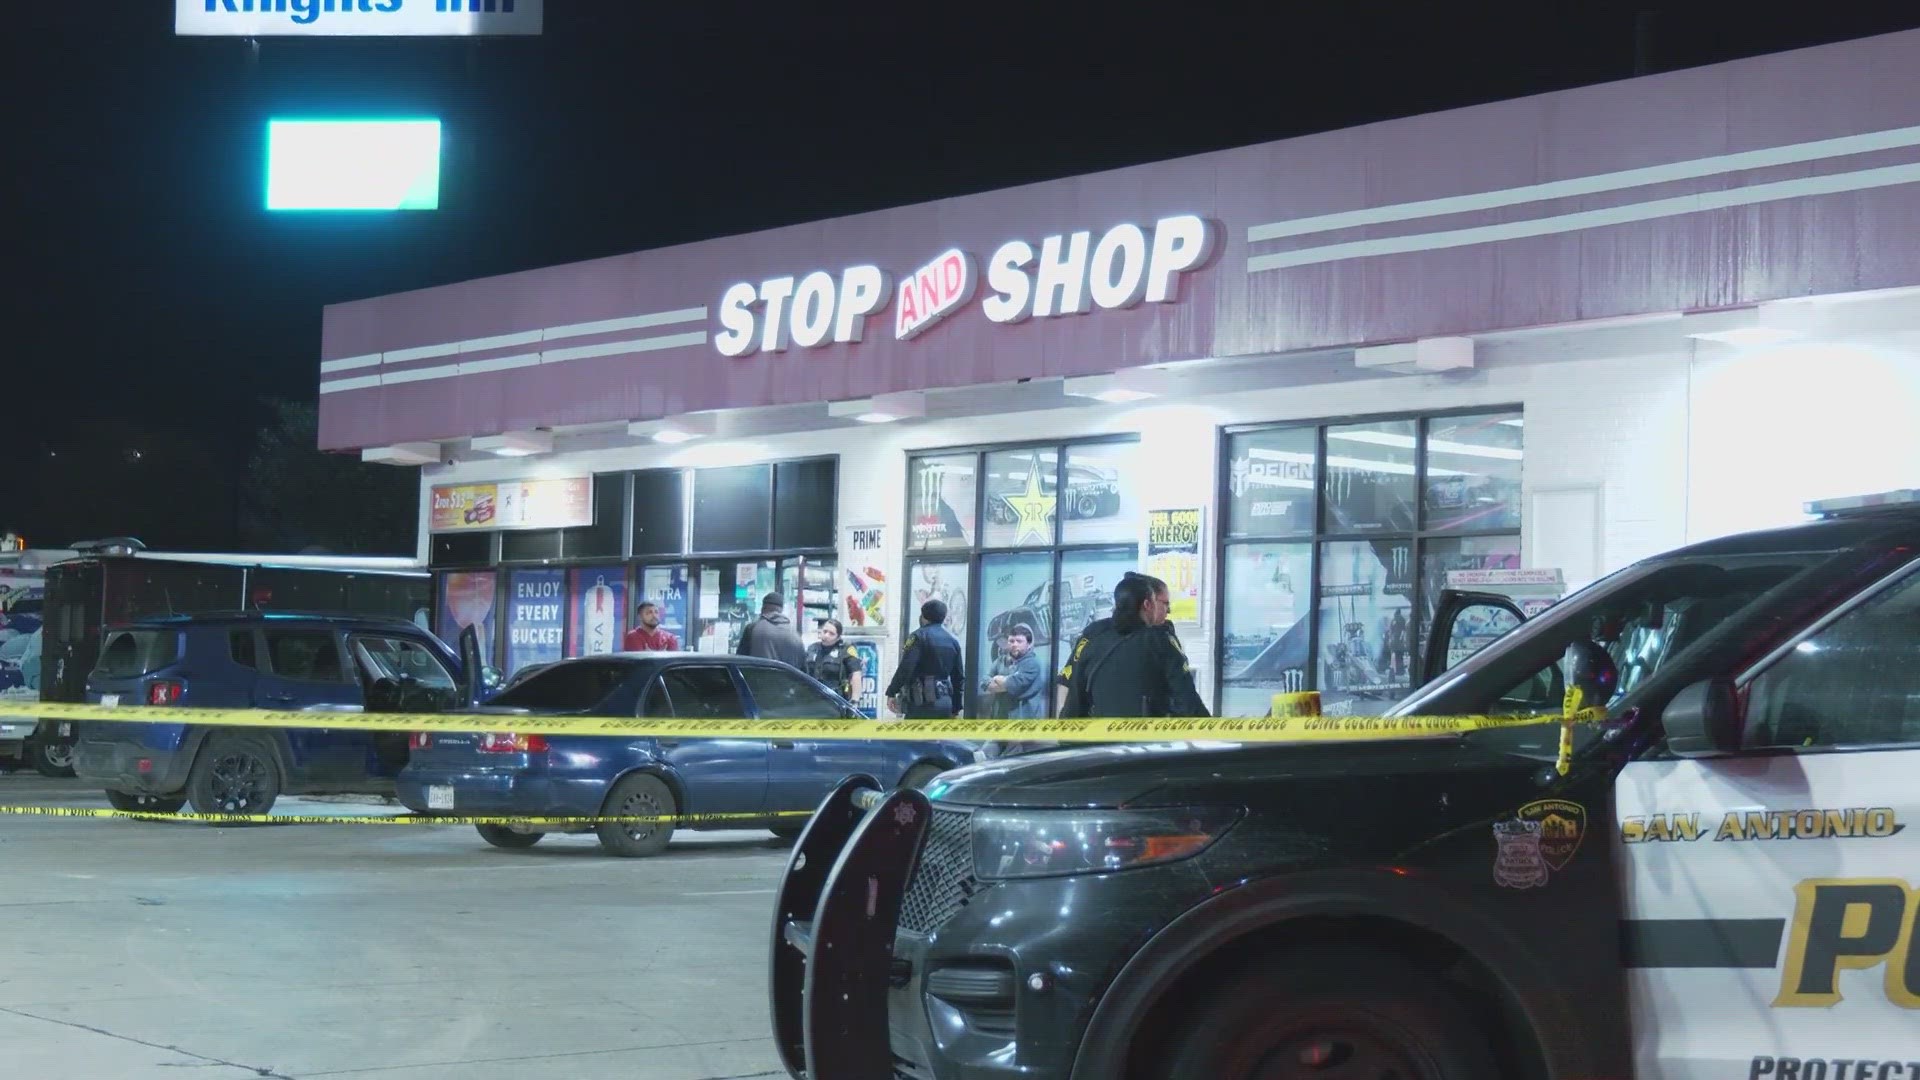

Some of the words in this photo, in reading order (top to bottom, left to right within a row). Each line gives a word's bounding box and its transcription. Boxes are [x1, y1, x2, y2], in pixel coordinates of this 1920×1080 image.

[714, 264, 892, 357] STOP
[897, 253, 967, 332] AND
[982, 215, 1208, 324] SHOP
[853, 529, 882, 550] PRIME
[1149, 525, 1199, 543] ENERGY
[518, 582, 561, 598] ENJOY
[647, 588, 682, 600] ULTRA
[517, 605, 559, 621] EVERY
[512, 629, 563, 644] BUCKET
[1622, 812, 1700, 843] SAN
[1714, 807, 1900, 841] ANTONIO
